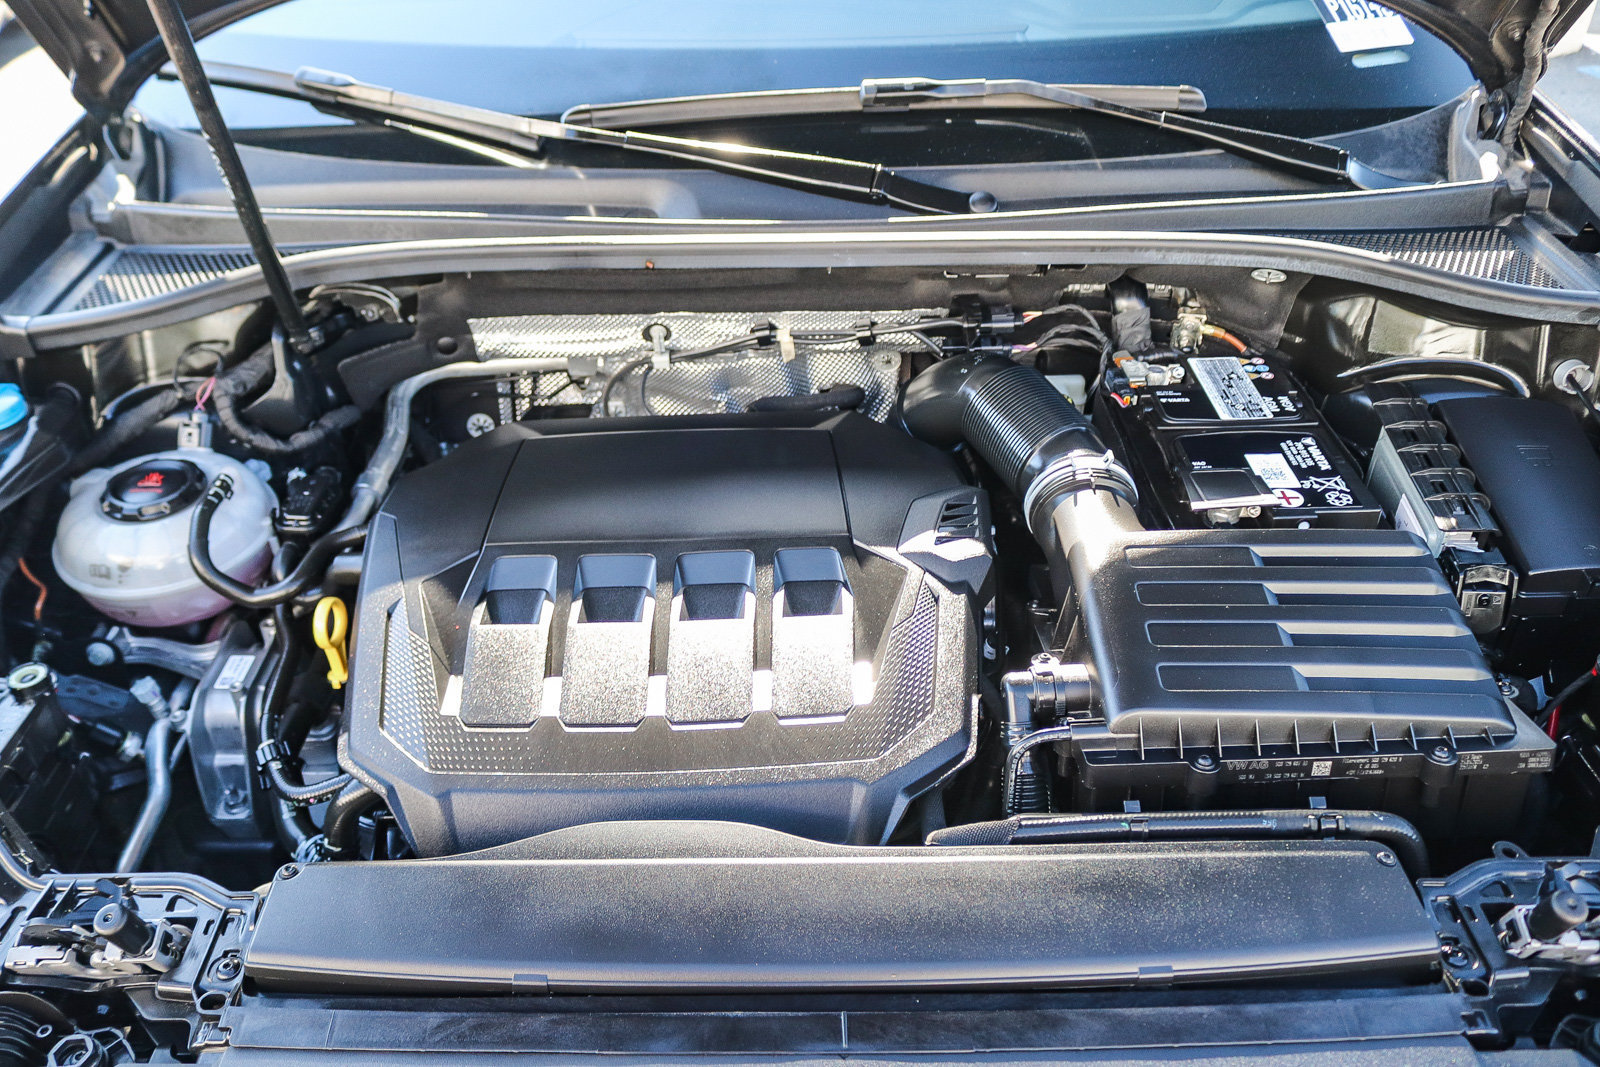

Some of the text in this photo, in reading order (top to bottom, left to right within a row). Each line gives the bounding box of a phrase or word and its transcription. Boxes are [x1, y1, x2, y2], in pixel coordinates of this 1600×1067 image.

[1307, 445, 1332, 471] VARTA
[1226, 760, 1269, 770] VW AG
